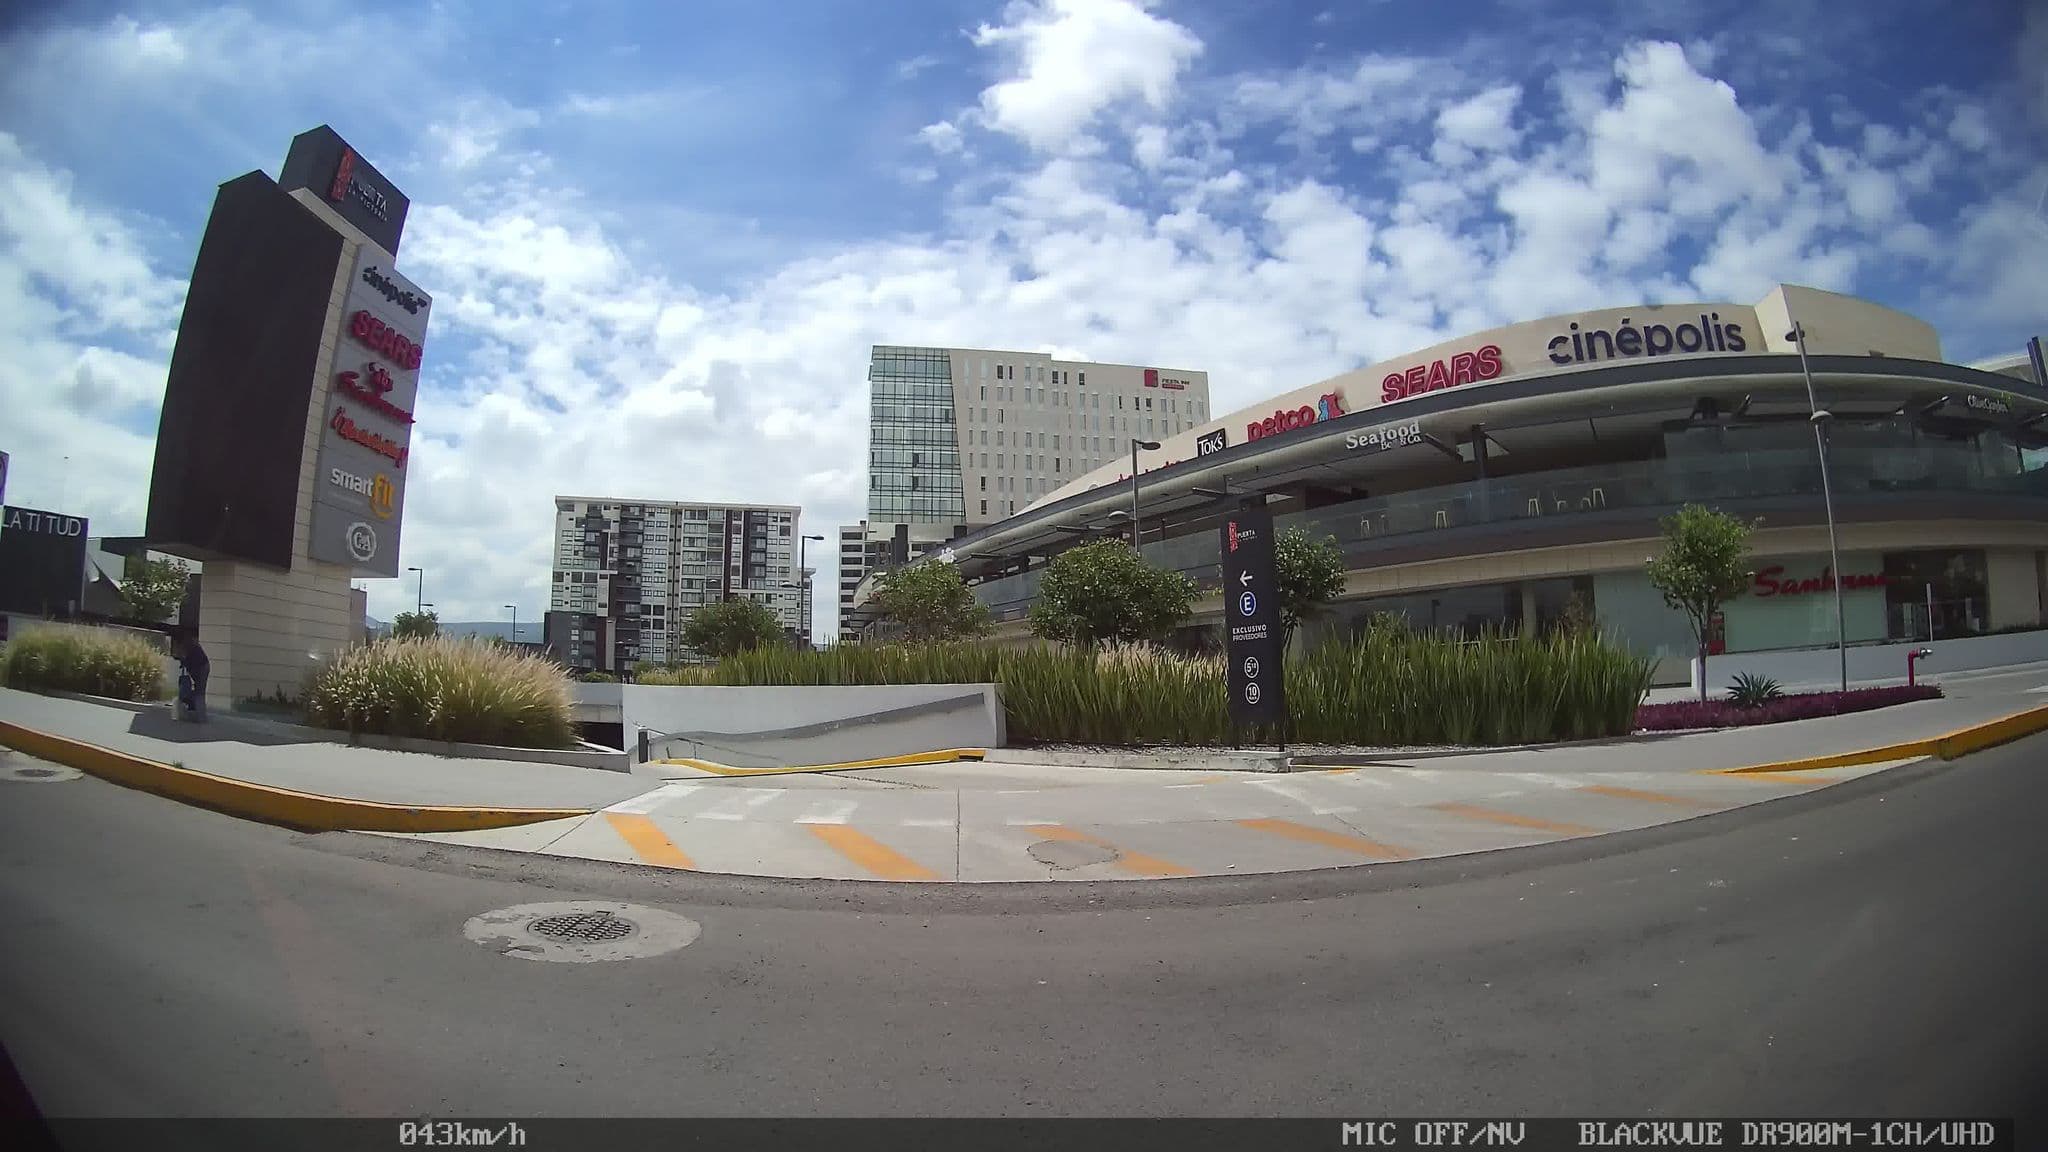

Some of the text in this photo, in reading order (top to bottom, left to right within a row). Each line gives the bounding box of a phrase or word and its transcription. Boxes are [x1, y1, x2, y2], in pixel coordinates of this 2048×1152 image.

[353, 310, 423, 370] SEARS
[1548, 313, 1747, 364] cinépolis
[1381, 345, 1503, 403] SEARS
[1246, 405, 1316, 442] petco
[1346, 420, 1421, 449] Seafood
[1243, 596, 1253, 612] E
[1232, 623, 1268, 636] EXCLUSIVO
